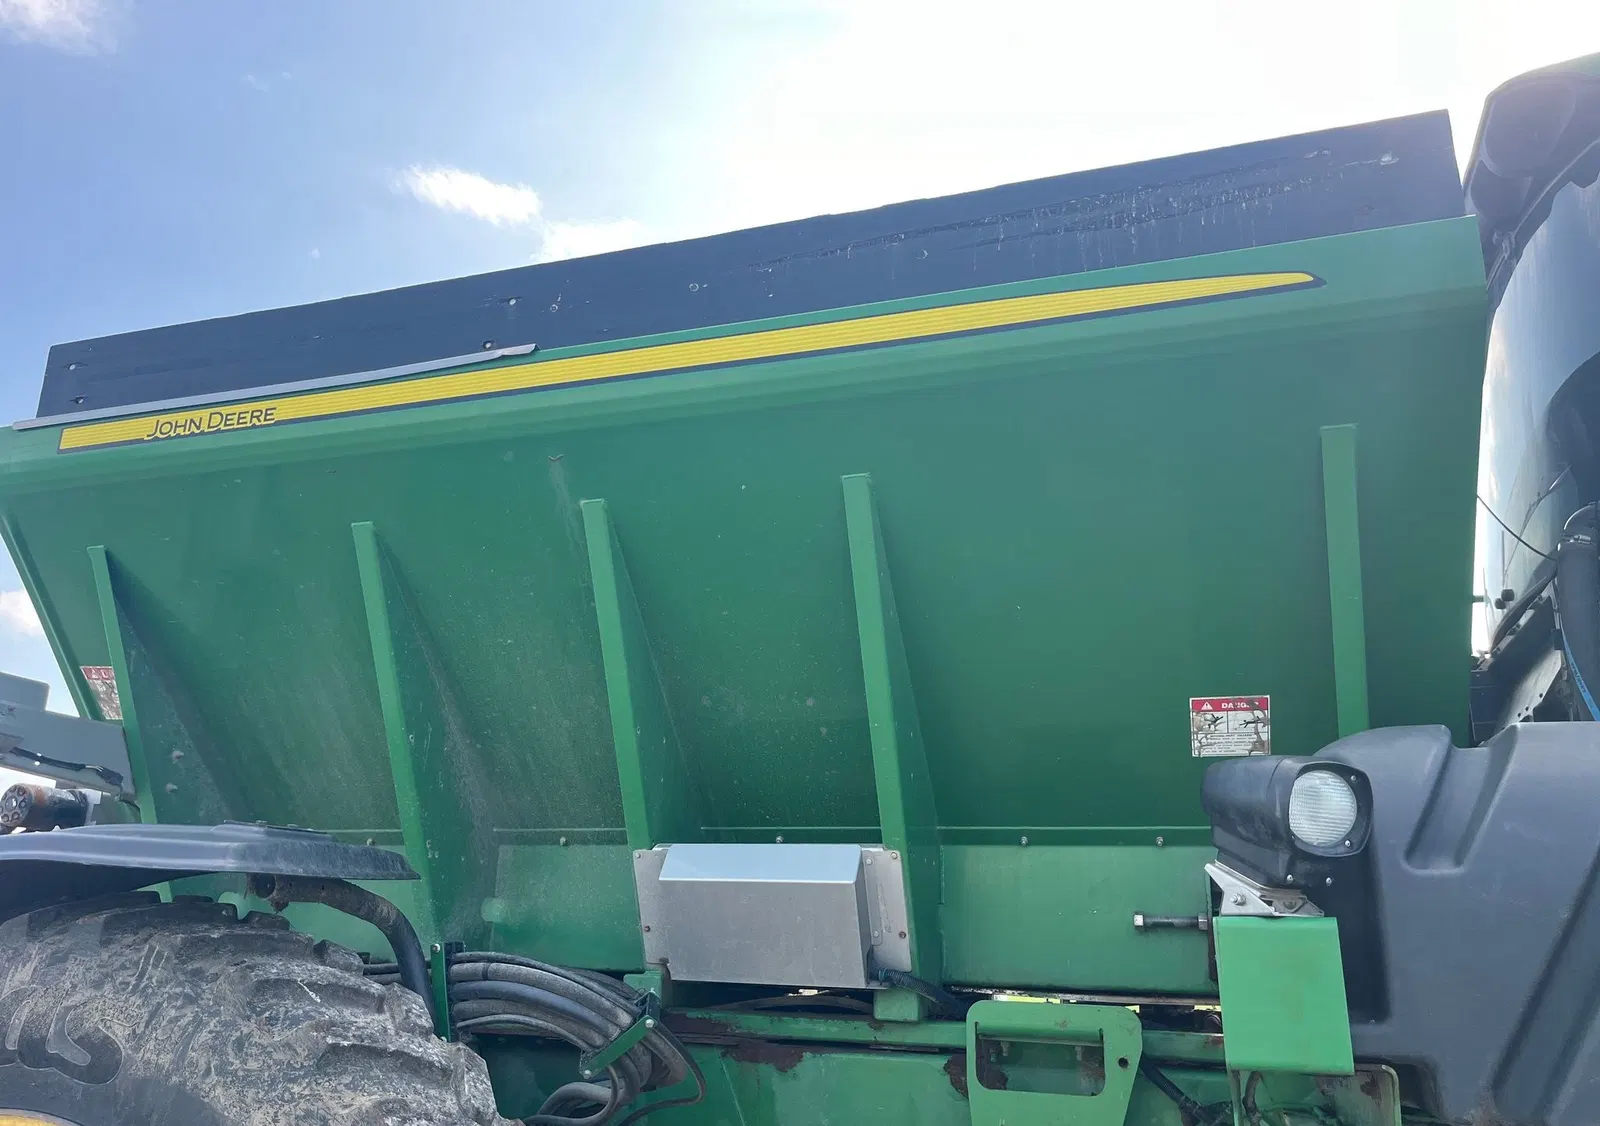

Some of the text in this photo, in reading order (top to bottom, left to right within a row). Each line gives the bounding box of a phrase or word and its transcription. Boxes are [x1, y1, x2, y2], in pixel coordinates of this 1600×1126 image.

[146, 406, 277, 438] JOHN DEERE
[1221, 701, 1259, 710] DAG
